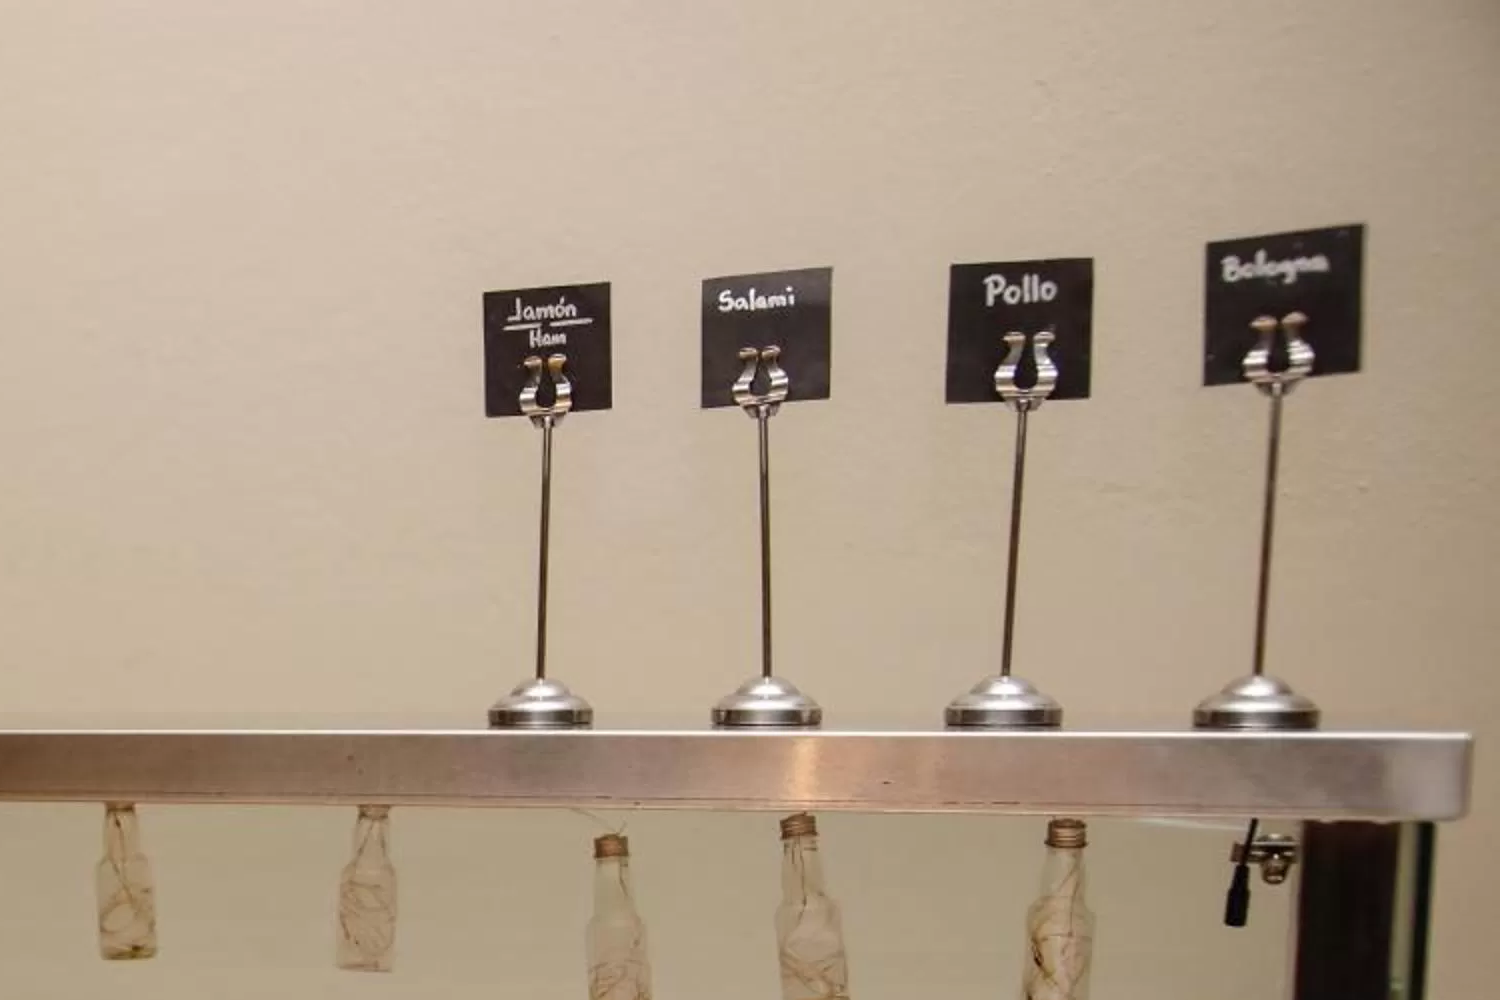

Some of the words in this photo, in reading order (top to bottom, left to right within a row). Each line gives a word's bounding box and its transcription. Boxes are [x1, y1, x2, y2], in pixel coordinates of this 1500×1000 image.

[1220, 249, 1330, 284] Bologna
[718, 286, 796, 312] Salami
[983, 273, 1058, 307] Pollo
[507, 297, 577, 322] Jamón
[529, 328, 567, 347] Ham
